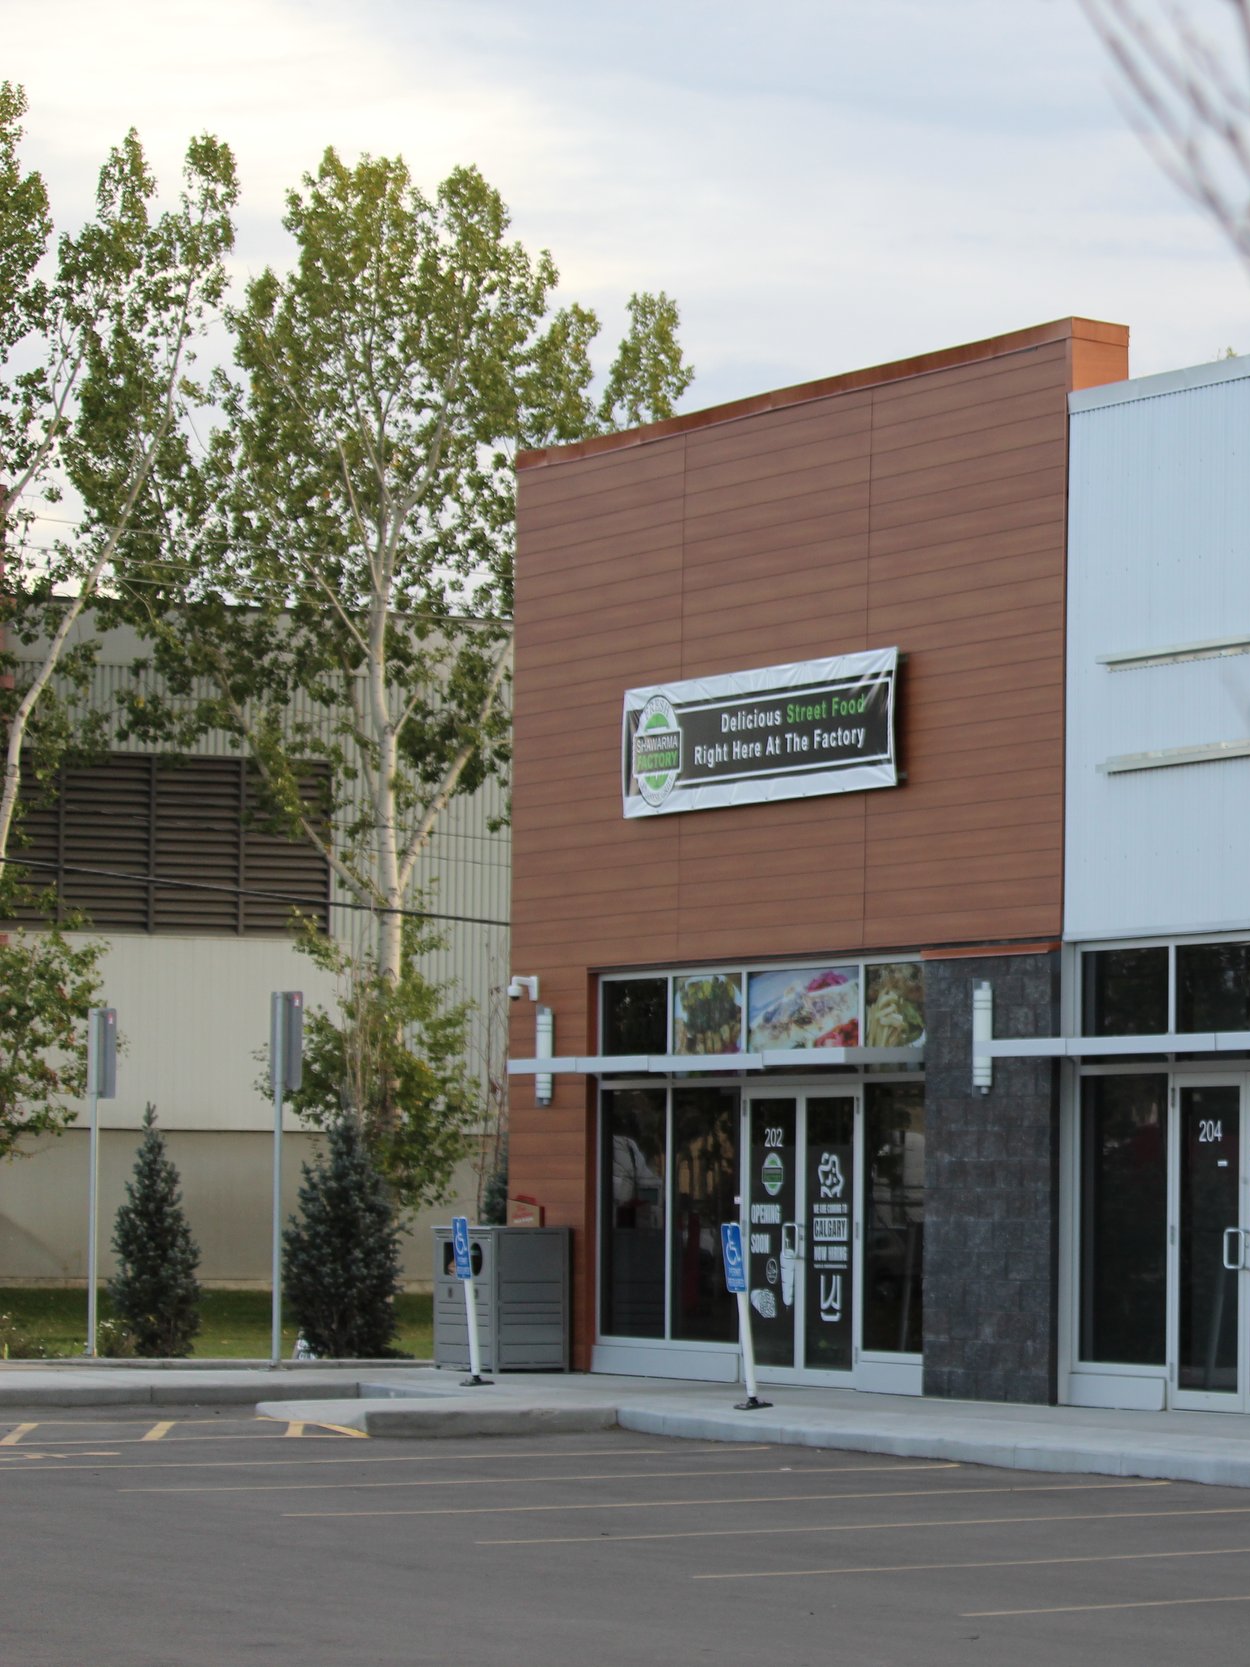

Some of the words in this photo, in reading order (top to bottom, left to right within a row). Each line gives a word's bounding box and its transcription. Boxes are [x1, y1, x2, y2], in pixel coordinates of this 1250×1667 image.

[721, 709, 781, 733] Delicious
[786, 702, 828, 724] Street
[831, 694, 865, 717] Food
[636, 735, 678, 754] SHAWARMA
[694, 744, 728, 768] Right
[732, 740, 761, 761] Here
[766, 736, 780, 756] At
[785, 731, 808, 752] The
[813, 726, 865, 749] Factory
[636, 750, 678, 772] FACTORY
[764, 1128, 783, 1147] 202
[1199, 1120, 1222, 1142] 204
[751, 1204, 781, 1224] OPENING
[814, 1219, 846, 1238] CALGARY
[751, 1234, 770, 1254] SOON
